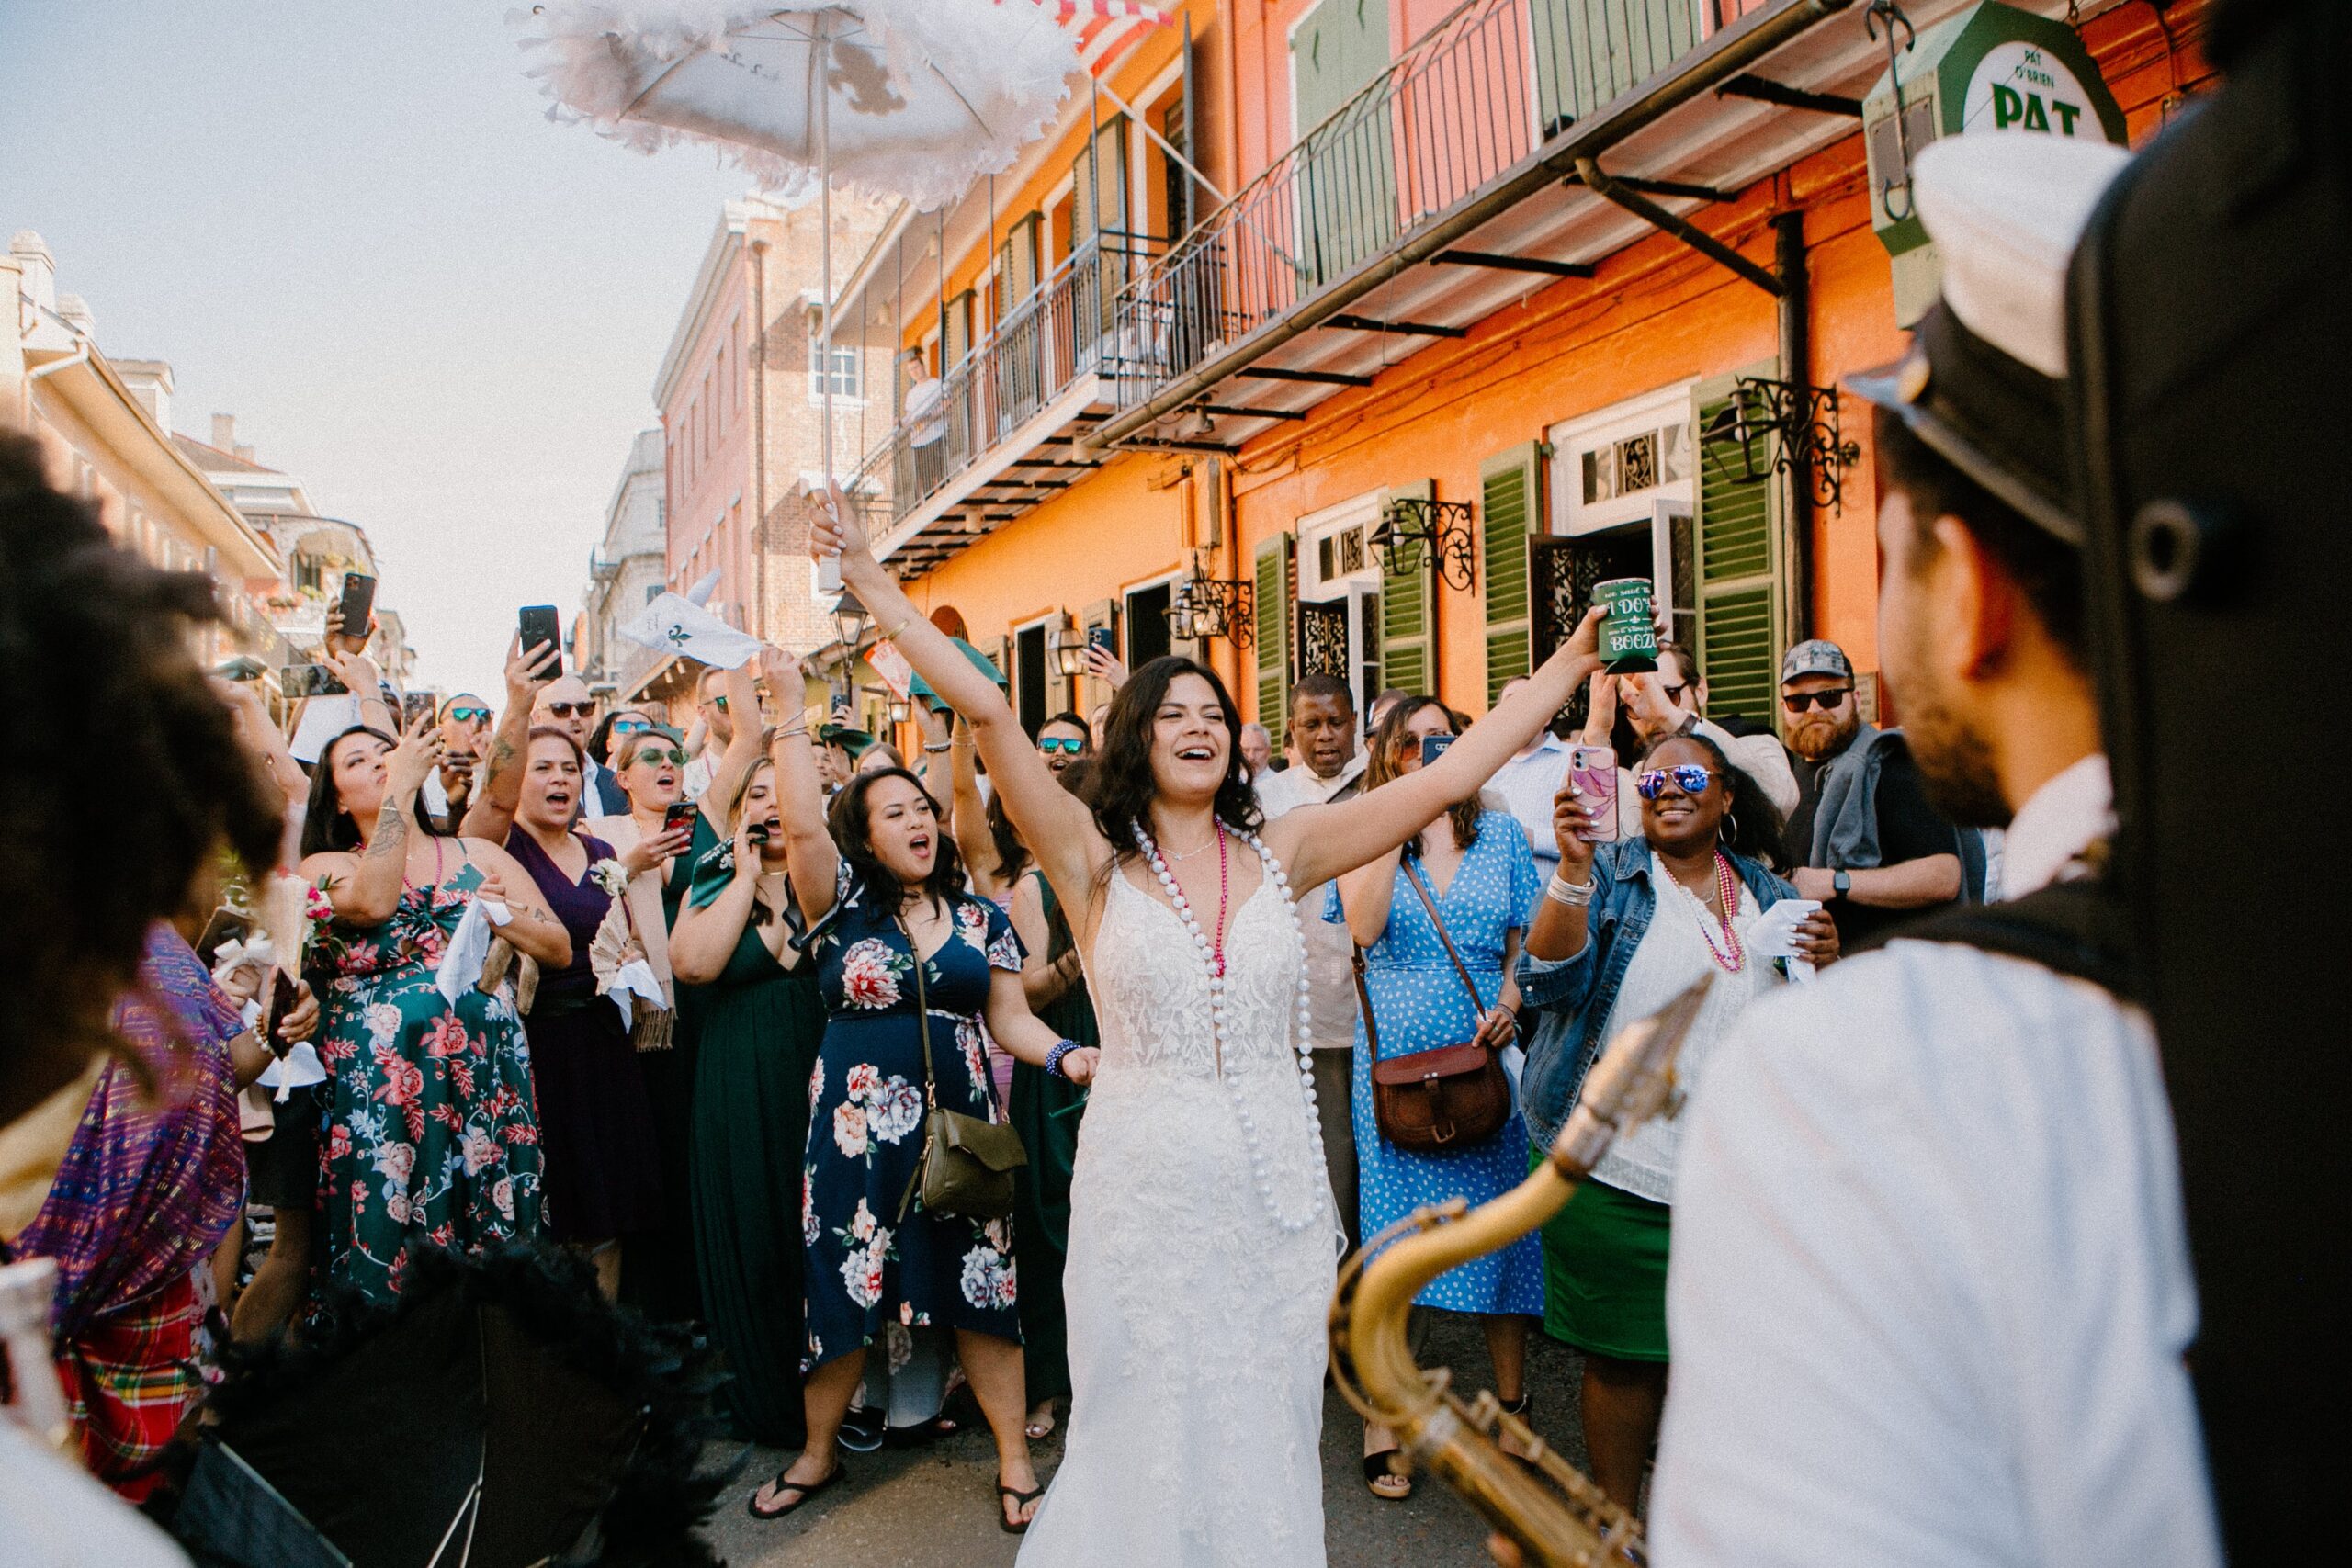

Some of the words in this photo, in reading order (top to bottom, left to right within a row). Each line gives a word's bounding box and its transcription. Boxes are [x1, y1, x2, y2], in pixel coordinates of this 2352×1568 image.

[2025, 50, 2041, 66] PAT
[2015, 65, 2054, 89] O'BRIEN
[1991, 82, 2081, 136] PAT
